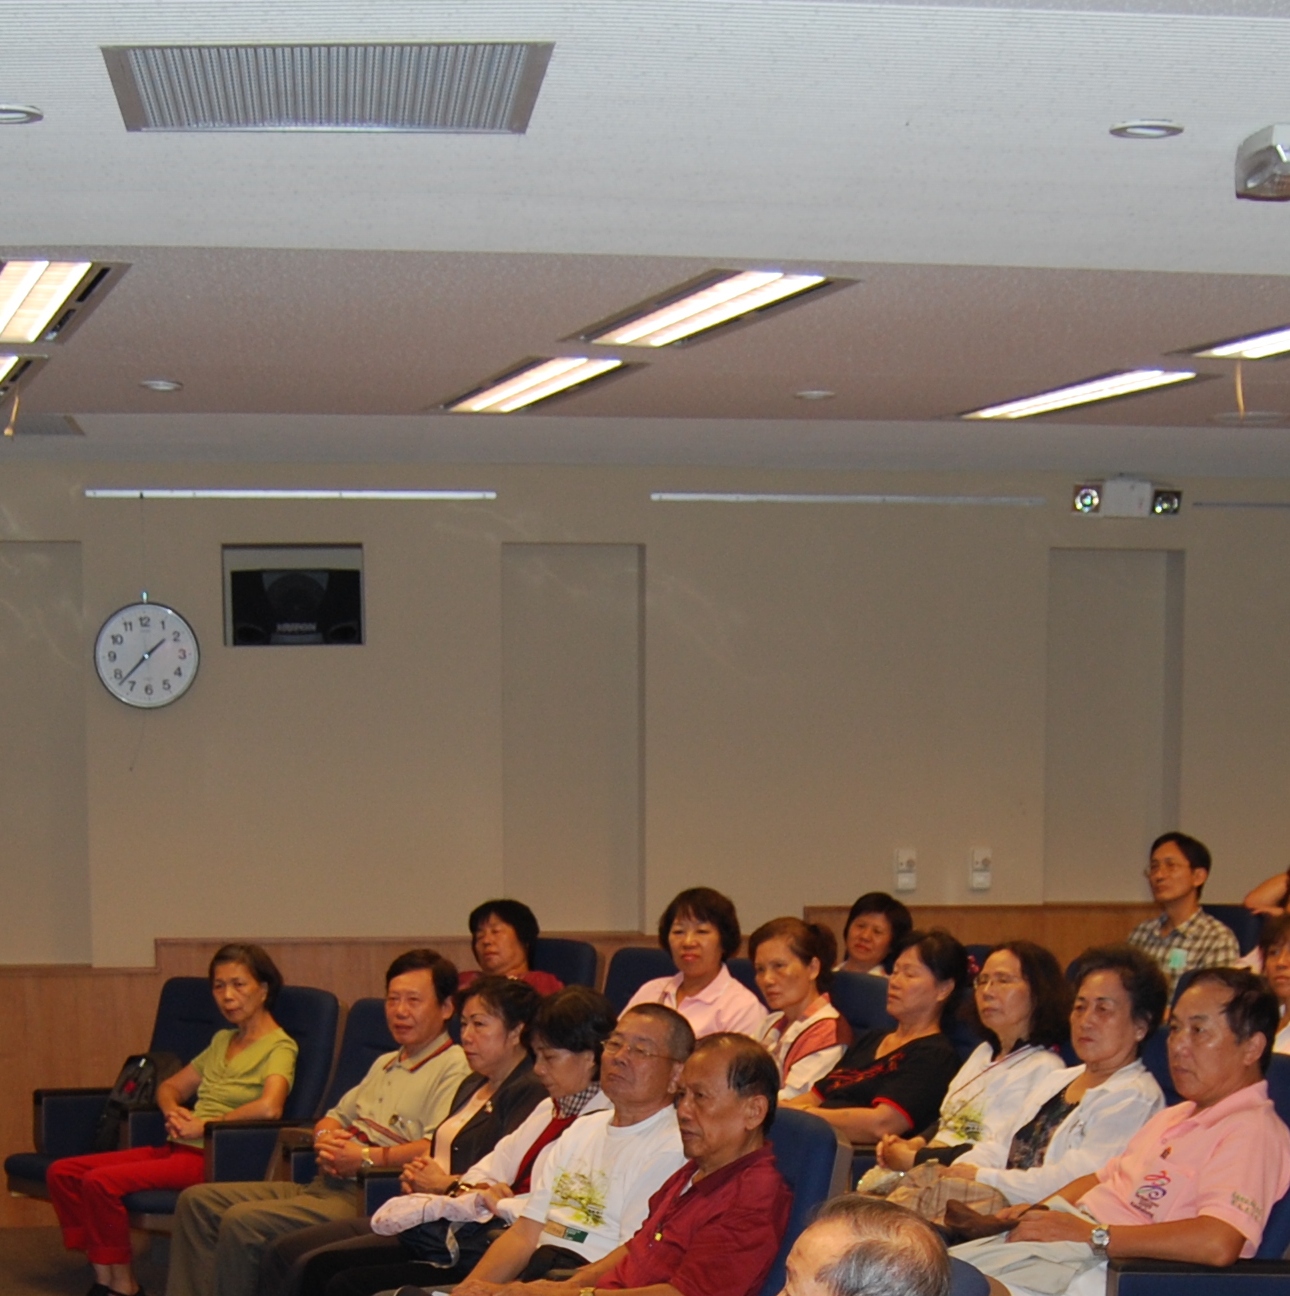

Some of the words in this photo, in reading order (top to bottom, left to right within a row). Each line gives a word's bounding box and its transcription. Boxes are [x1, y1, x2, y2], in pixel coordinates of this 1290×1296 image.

[123, 621, 133, 632] 11
[139, 616, 150, 627] 12
[161, 620, 166, 630] 1
[111, 634, 123, 645] 10
[172, 631, 180, 642] 2
[108, 651, 117, 662] 9
[178, 649, 187, 660] 3
[113, 668, 123, 680] 8
[173, 666, 182, 677] 4
[129, 680, 137, 692] 7
[144, 684, 154, 695] 6
[162, 679, 171, 691] 5
